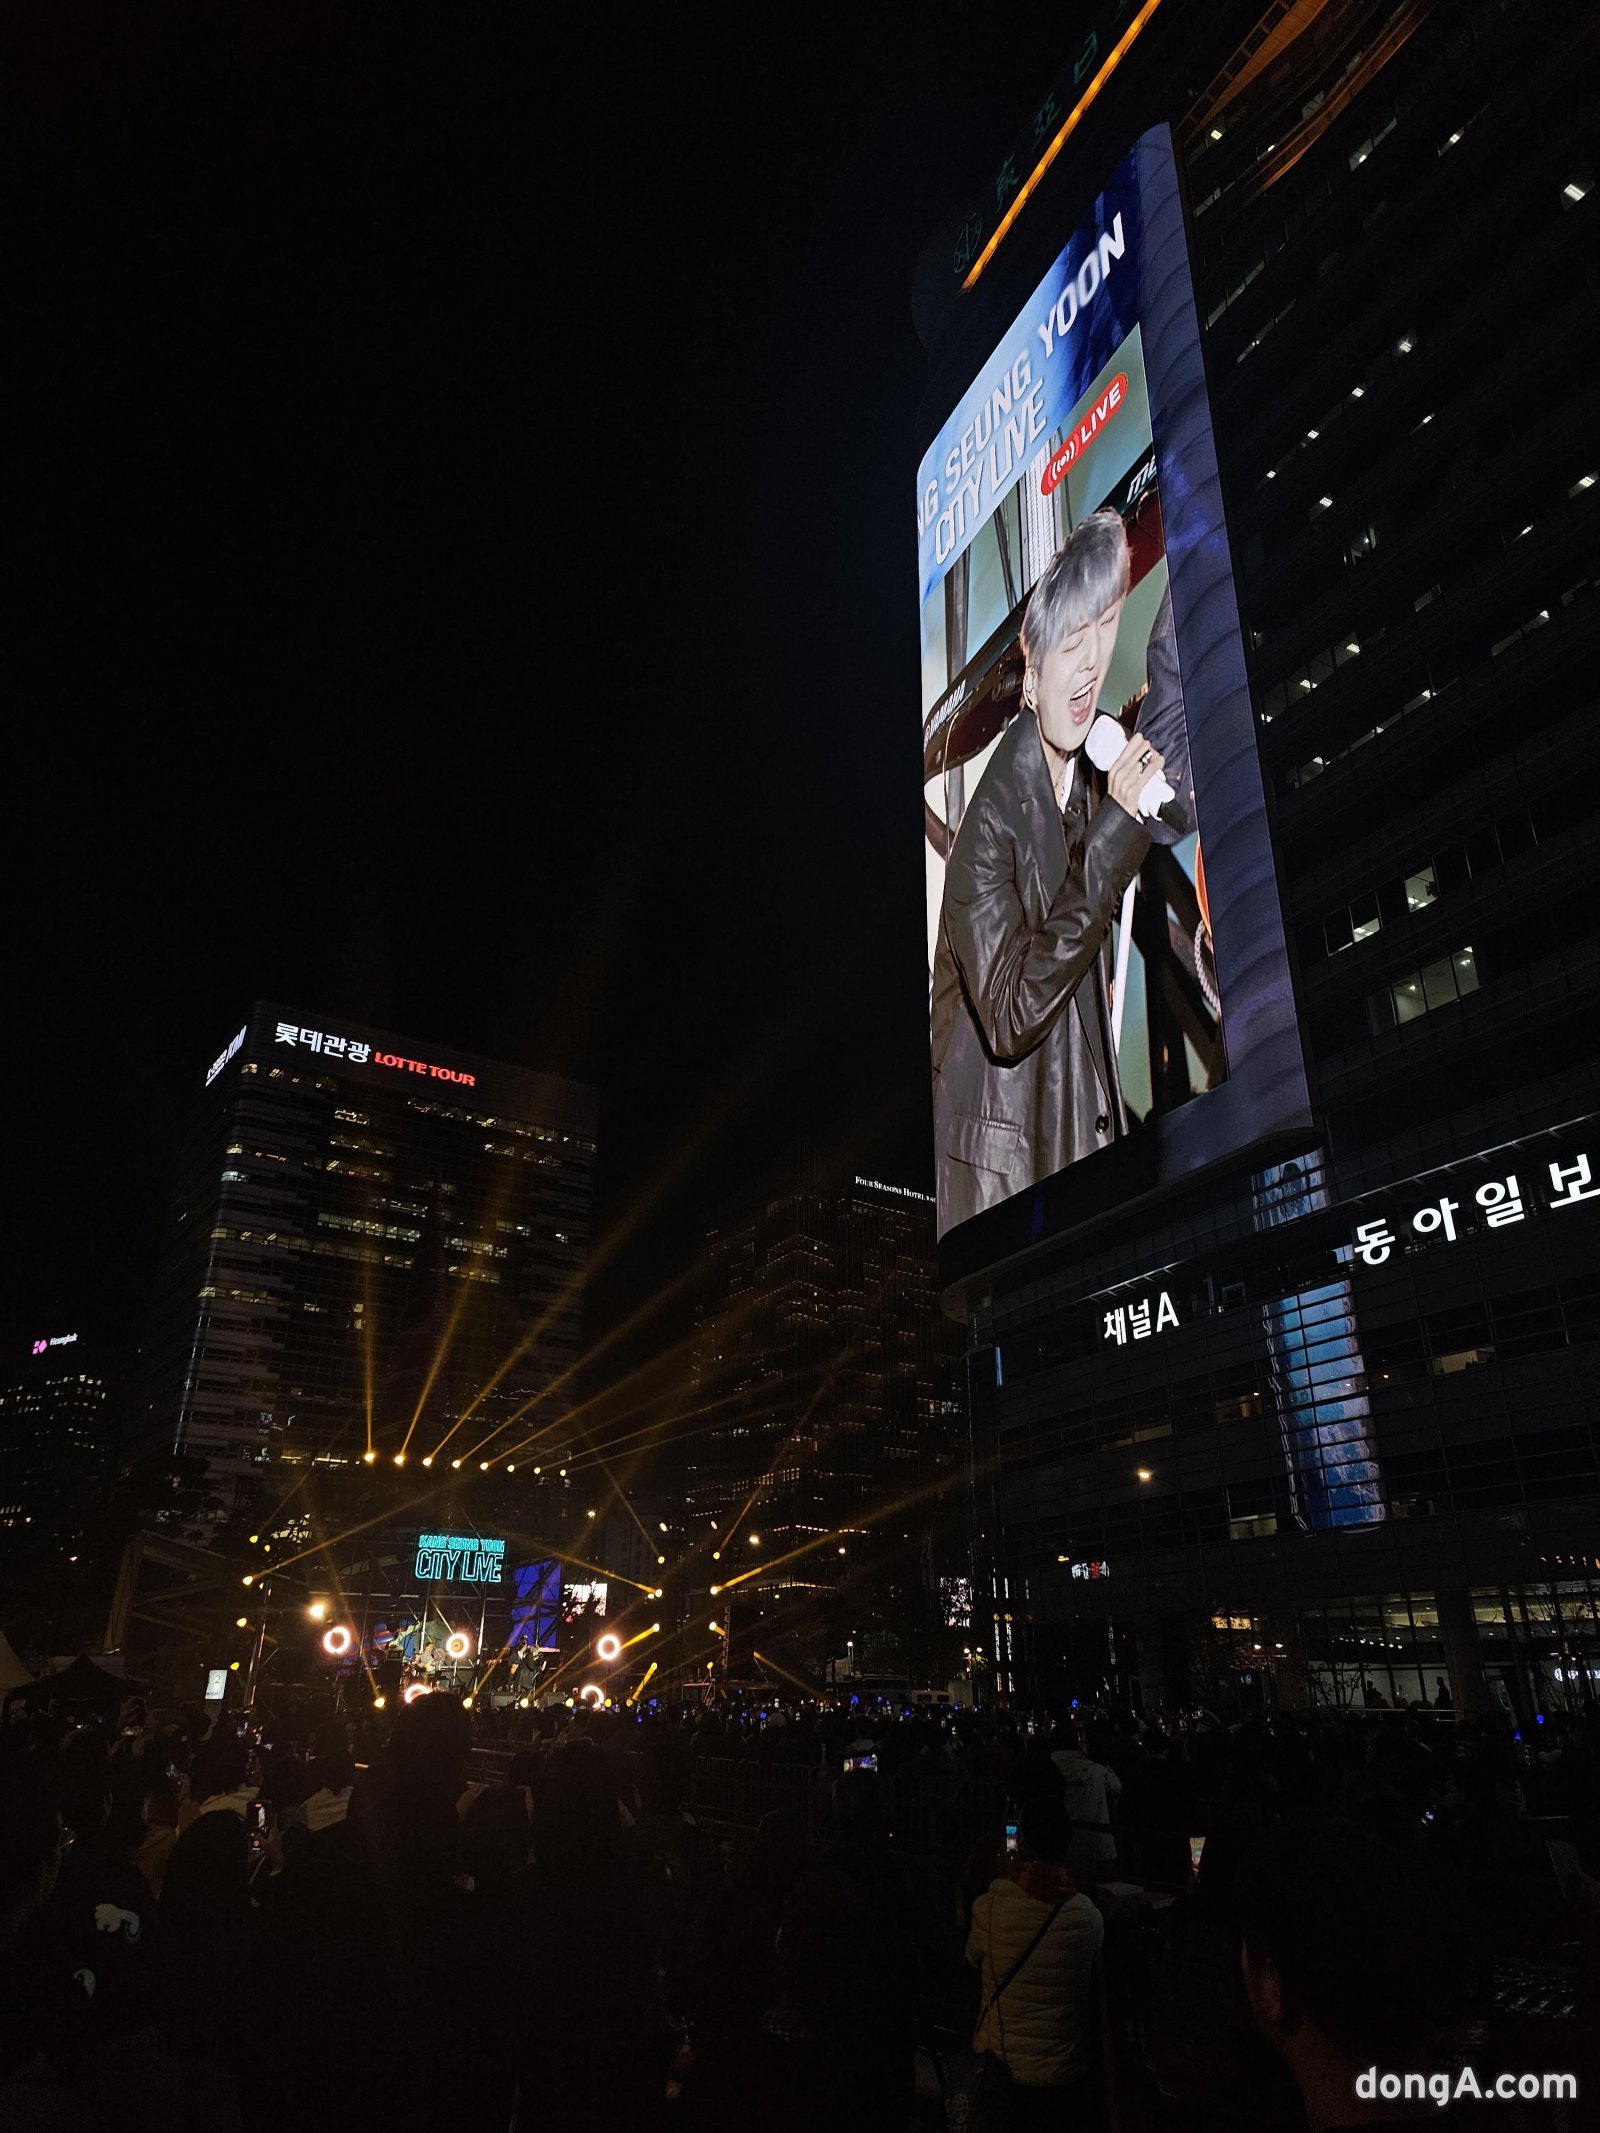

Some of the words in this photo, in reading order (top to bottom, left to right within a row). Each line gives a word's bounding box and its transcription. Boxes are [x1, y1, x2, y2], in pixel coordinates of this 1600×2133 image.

[945, 349, 1032, 495] SEUNG
[1037, 211, 1125, 358] YOON
[1079, 382, 1121, 443] LIVE
[935, 459, 984, 565] CITY
[990, 377, 1047, 494] LIVE
[275, 1022, 371, 1063] 롯데관광
[374, 1051, 427, 1075] LOTTE
[429, 1065, 476, 1087] TOUR
[1354, 1153, 1600, 1265] 동아일보
[1103, 1291, 1180, 1346] 채널A
[415, 1549, 461, 1580] CITY
[461, 1551, 504, 1583] LIVE
[419, 1535, 447, 1549] KANG
